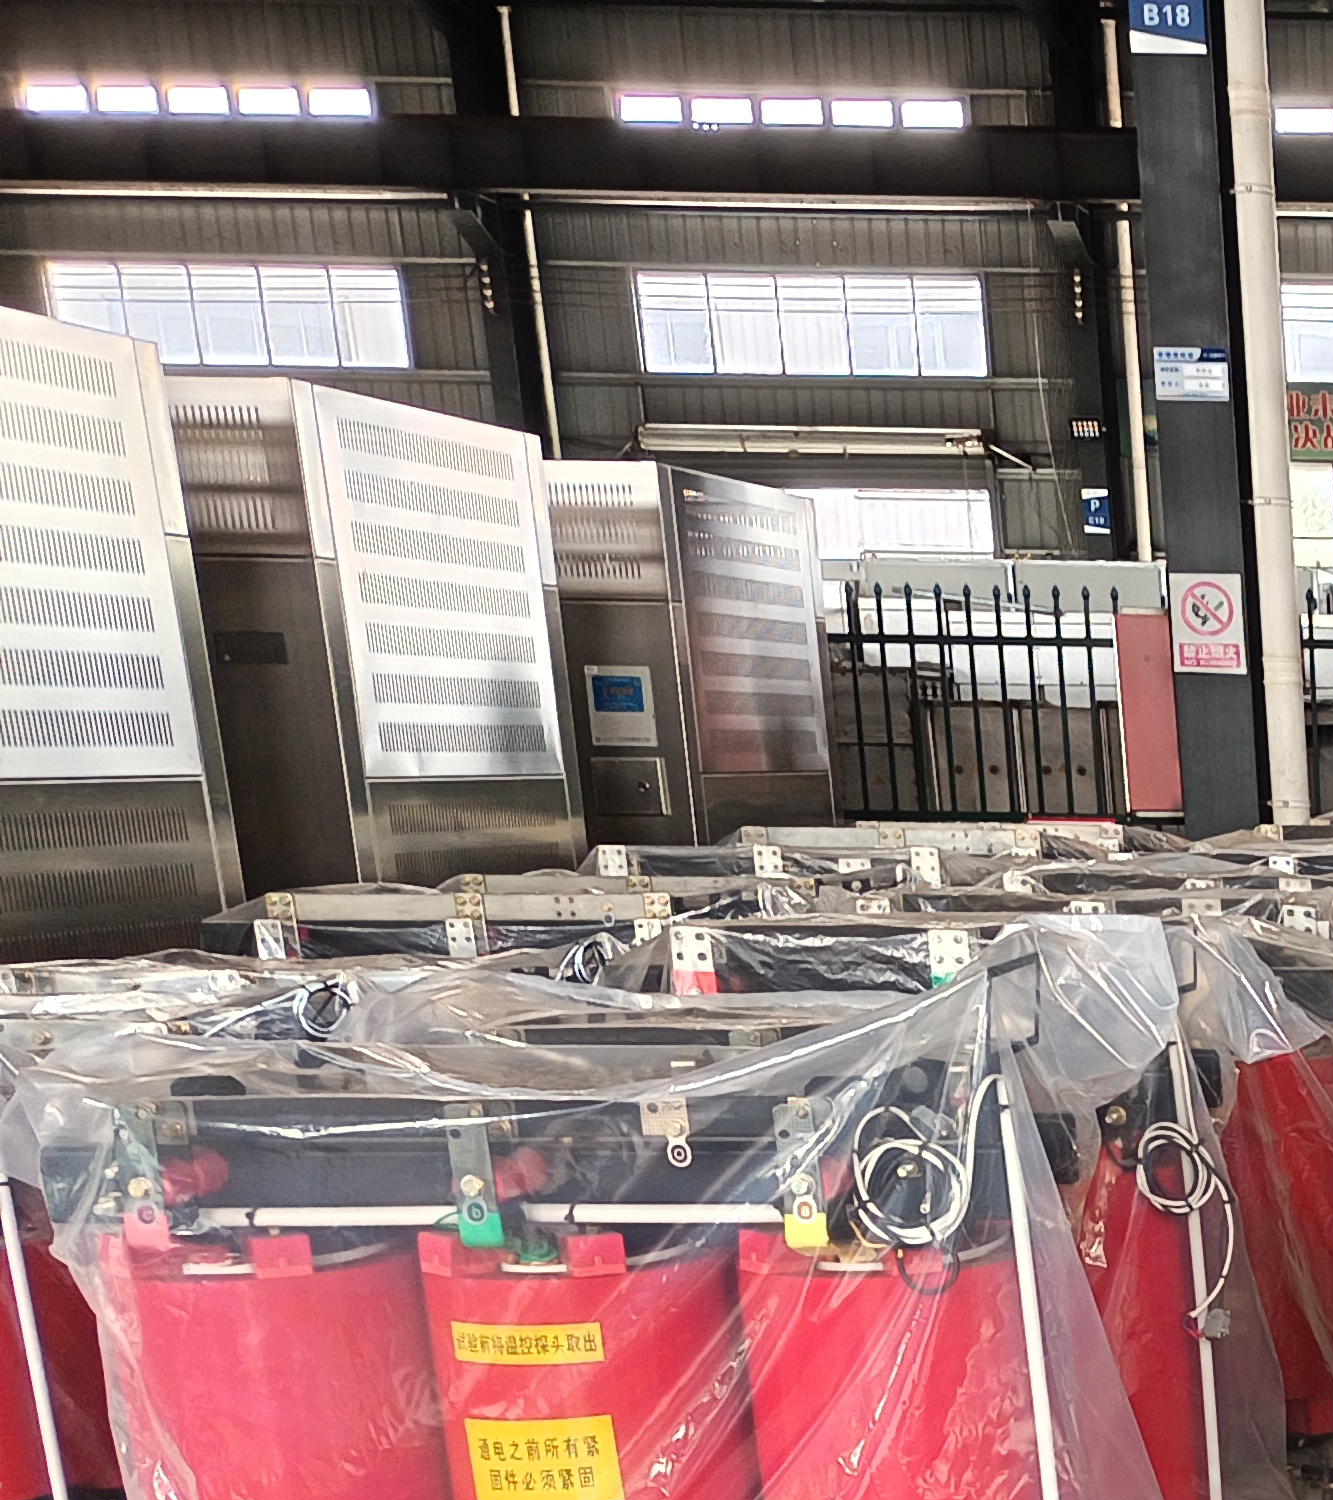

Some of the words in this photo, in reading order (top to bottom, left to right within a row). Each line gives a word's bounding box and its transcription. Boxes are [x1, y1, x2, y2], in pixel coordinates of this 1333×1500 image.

[1142, 3, 1191, 28] B18
[456, 1331, 598, 1356] 试验前将温控探头取出
[477, 1434, 601, 1462] 通电之前所有紧
[488, 1465, 596, 1492] 固件必须紧固
